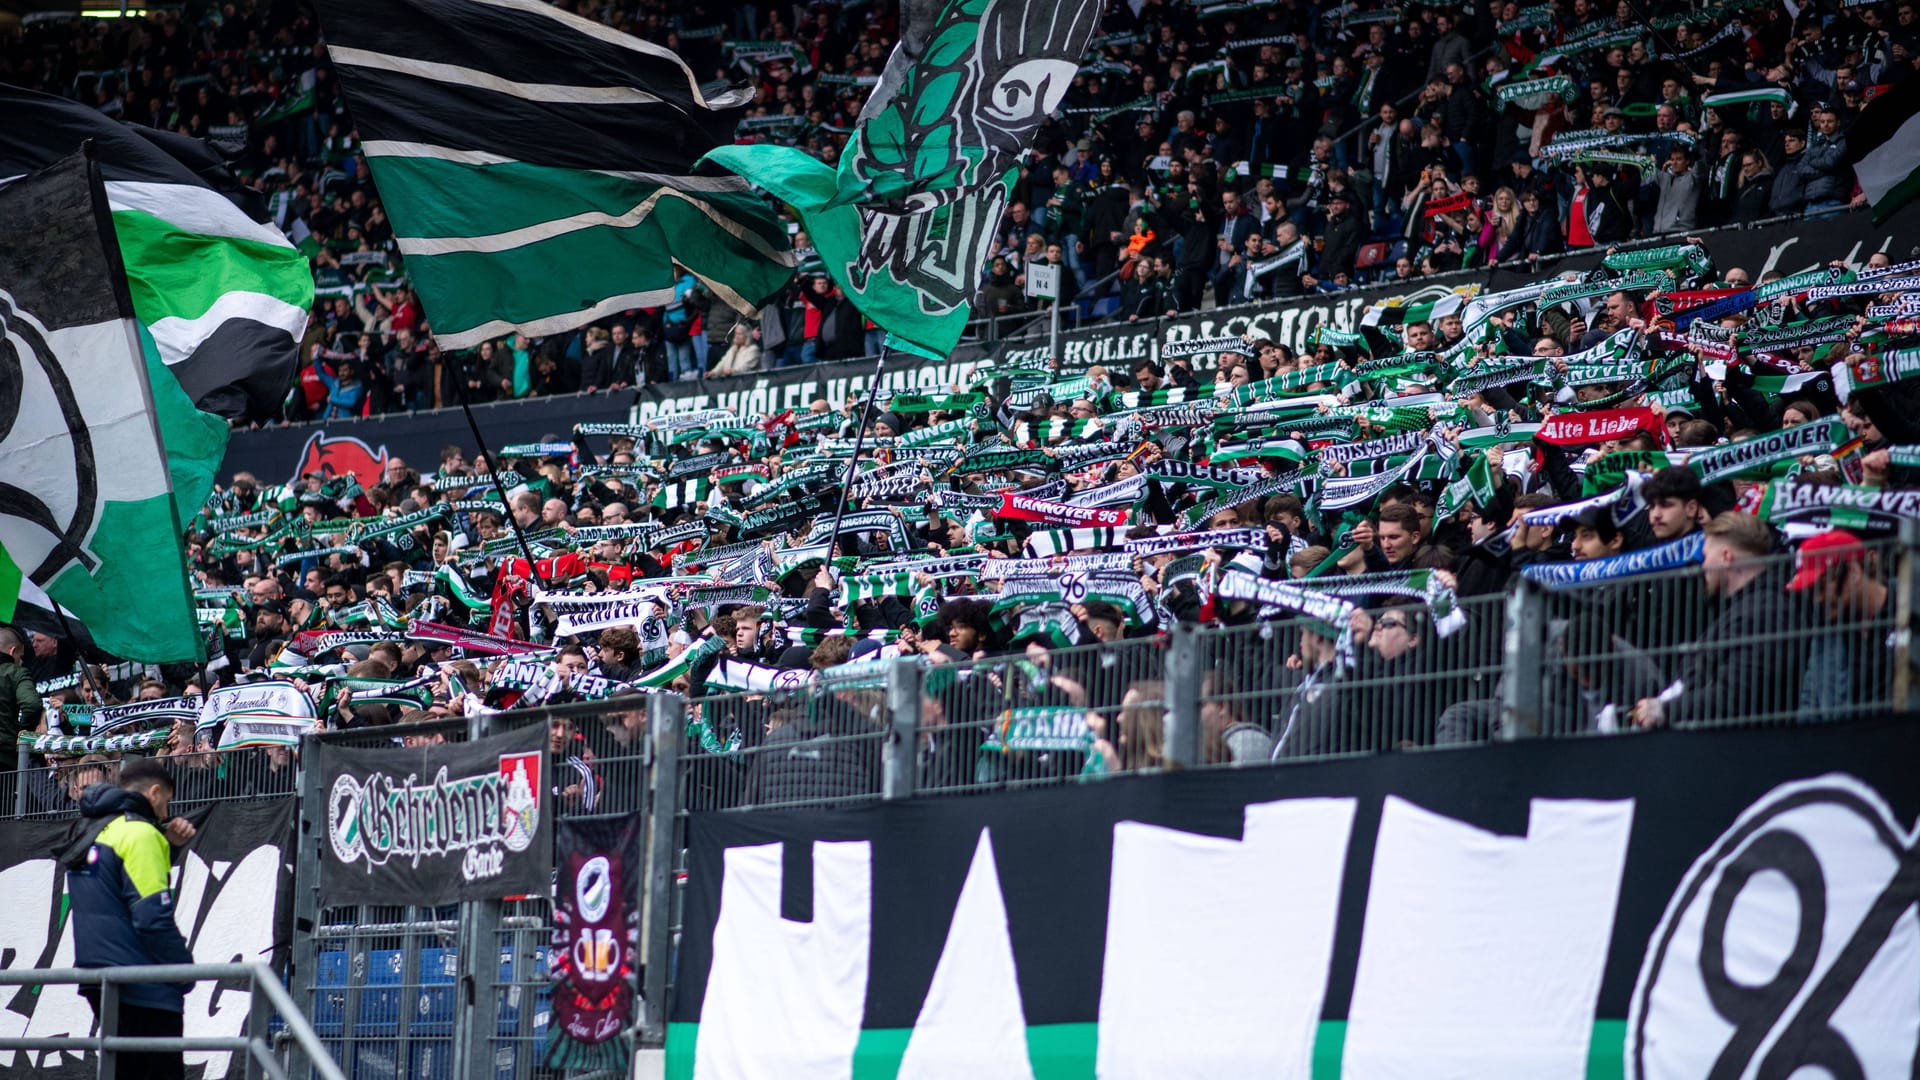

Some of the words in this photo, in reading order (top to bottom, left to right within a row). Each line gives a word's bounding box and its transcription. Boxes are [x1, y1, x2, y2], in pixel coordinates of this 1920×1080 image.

[1761, 271, 1825, 297] HANNOVER
[1165, 298, 1365, 356] PASSION
[1062, 333, 1149, 365] HÖLLE
[1752, 341, 1786, 355] TRADITION
[1786, 341, 1800, 351] HAT
[1801, 336, 1822, 346] EINEN
[1356, 352, 1436, 377] HANNOVER
[717, 380, 817, 416] WÖLFE
[826, 360, 996, 412] HANNOVER
[973, 404, 989, 417] 96
[578, 422, 649, 436] HANNOVER
[1497, 423, 1509, 434] 96
[1544, 418, 1584, 439] Alte
[1587, 415, 1640, 437] Liebe
[1701, 423, 1832, 474] HANNOVER
[433, 474, 475, 491] NIEMALS
[367, 504, 450, 533] HANNOVER
[1012, 496, 1094, 521] HANNOVER
[1097, 509, 1120, 524] 96
[400, 536, 414, 548] 96
[577, 528, 602, 541] STADT
[607, 526, 625, 539] UND
[1059, 572, 1086, 601] 96
[568, 603, 640, 627] HANNOVER
[921, 600, 939, 616] 96
[641, 620, 661, 640] 96
[102, 697, 177, 722] HANNOVER
[180, 696, 197, 710] 96
[359, 765, 509, 874] Gehrdener
[462, 847, 504, 882] Garde
